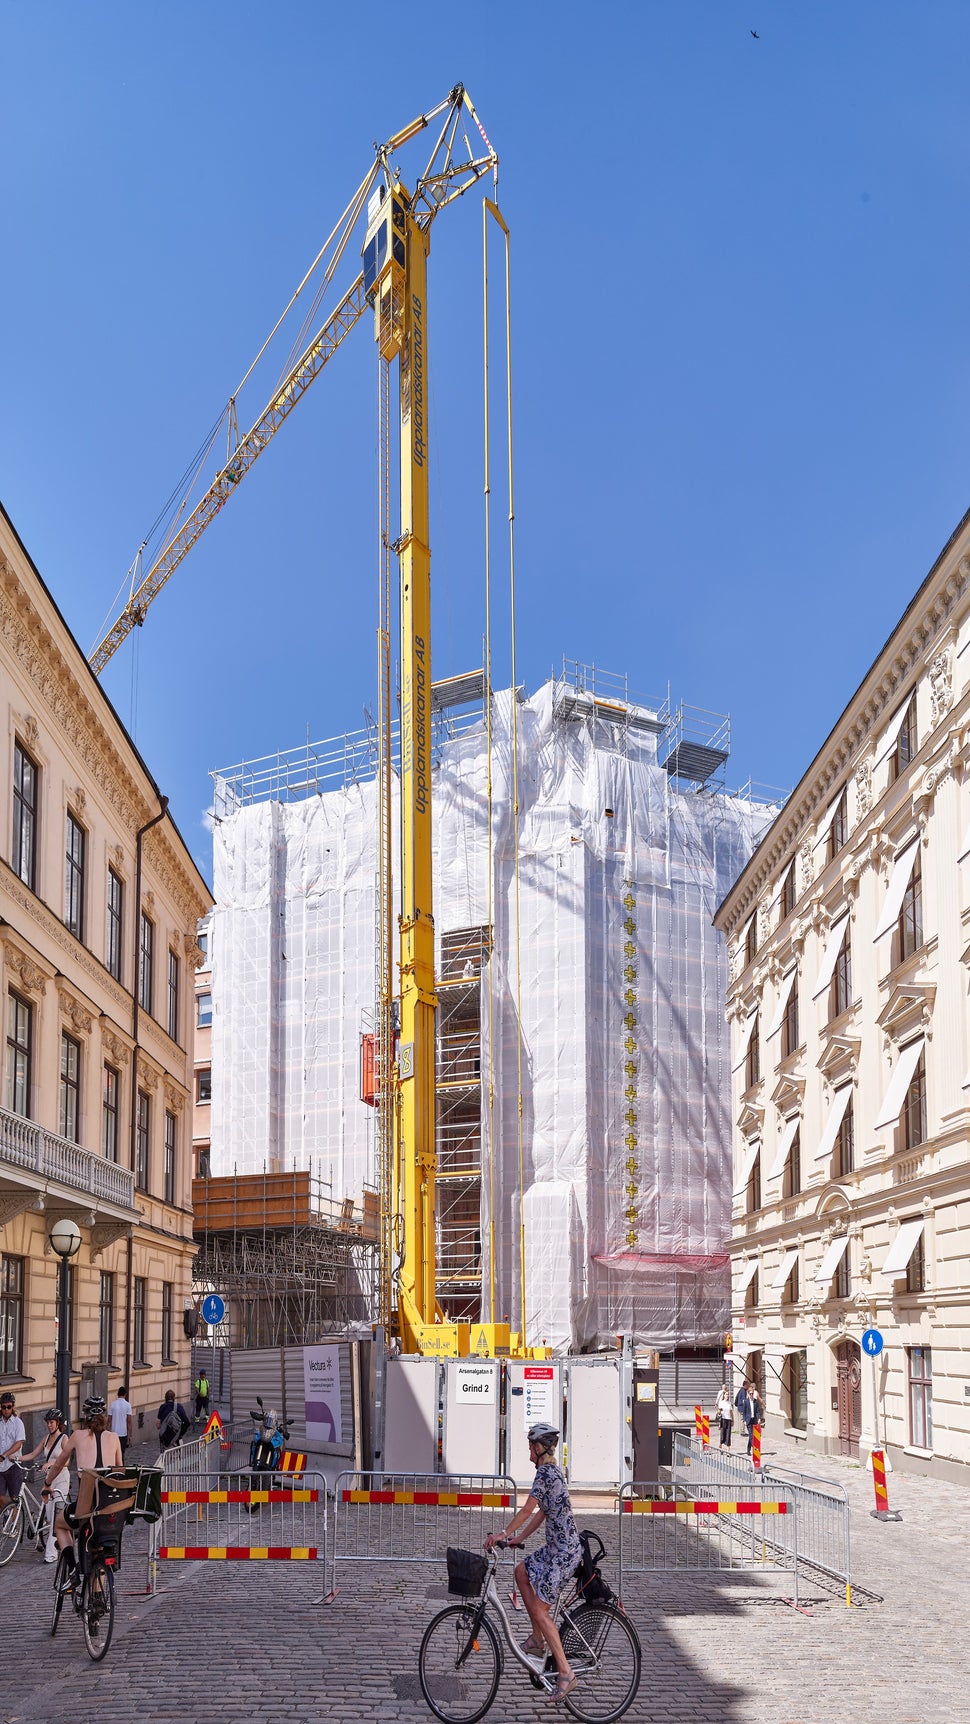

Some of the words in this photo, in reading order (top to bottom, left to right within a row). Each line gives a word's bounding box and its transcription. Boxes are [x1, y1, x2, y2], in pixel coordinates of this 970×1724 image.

[412, 294, 422, 325] AB
[413, 325, 426, 467] Upplandskranar
[415, 635, 425, 665] AB
[415, 665, 428, 815] Upplandskranar
[308, 1360, 326, 1371] Vectura
[462, 1384, 483, 1393] Grind
[484, 1384, 489, 1393] 2
